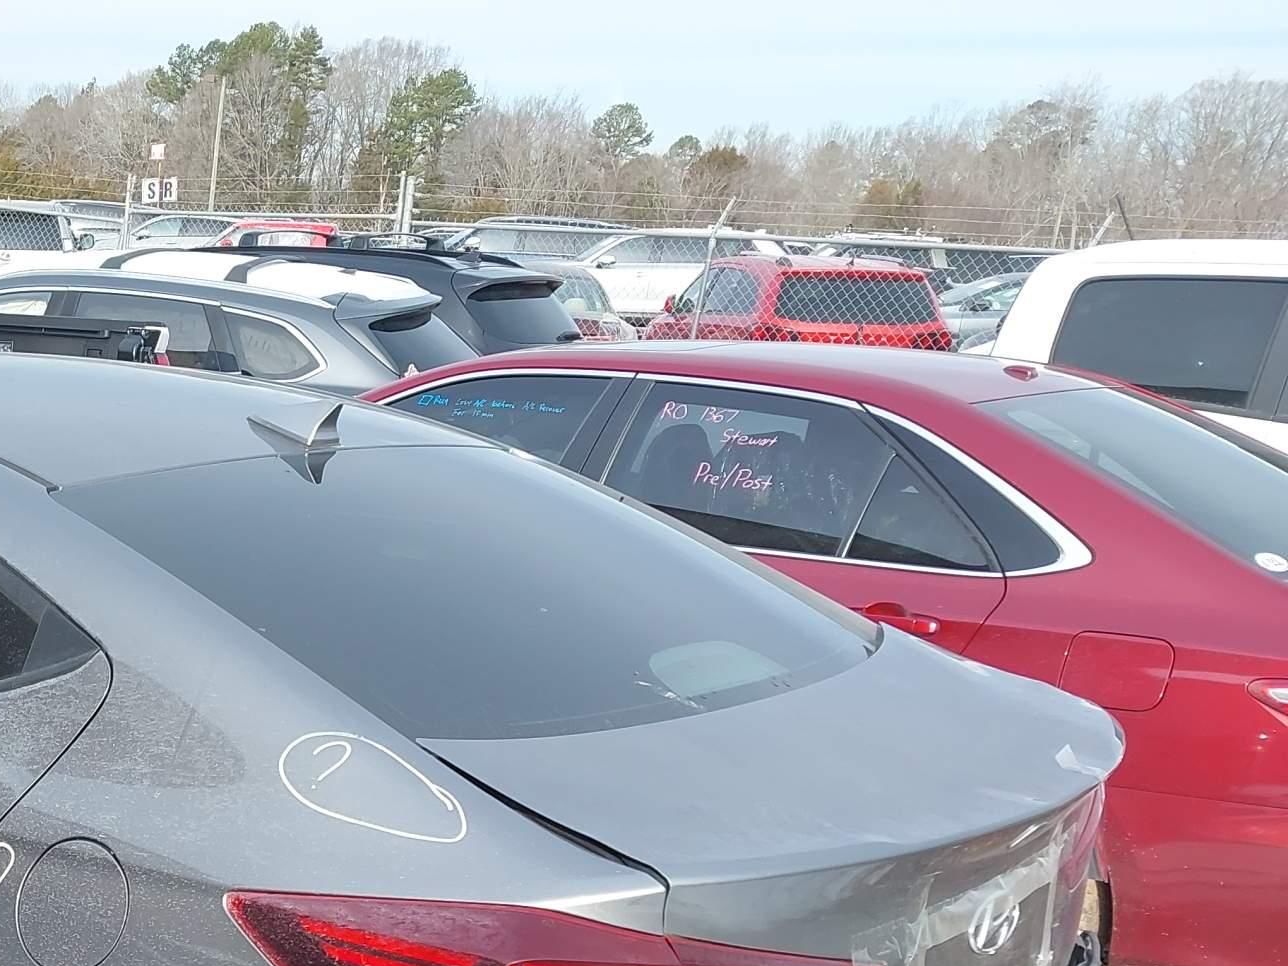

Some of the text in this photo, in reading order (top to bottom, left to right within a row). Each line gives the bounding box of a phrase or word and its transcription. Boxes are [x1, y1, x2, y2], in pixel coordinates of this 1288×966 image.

[147, 181, 156, 200] S
[163, 181, 173, 198] R
[659, 401, 740, 423] RO 1367
[720, 428, 779, 447] Stewart
[693, 462, 774, 491] Pre/Post
